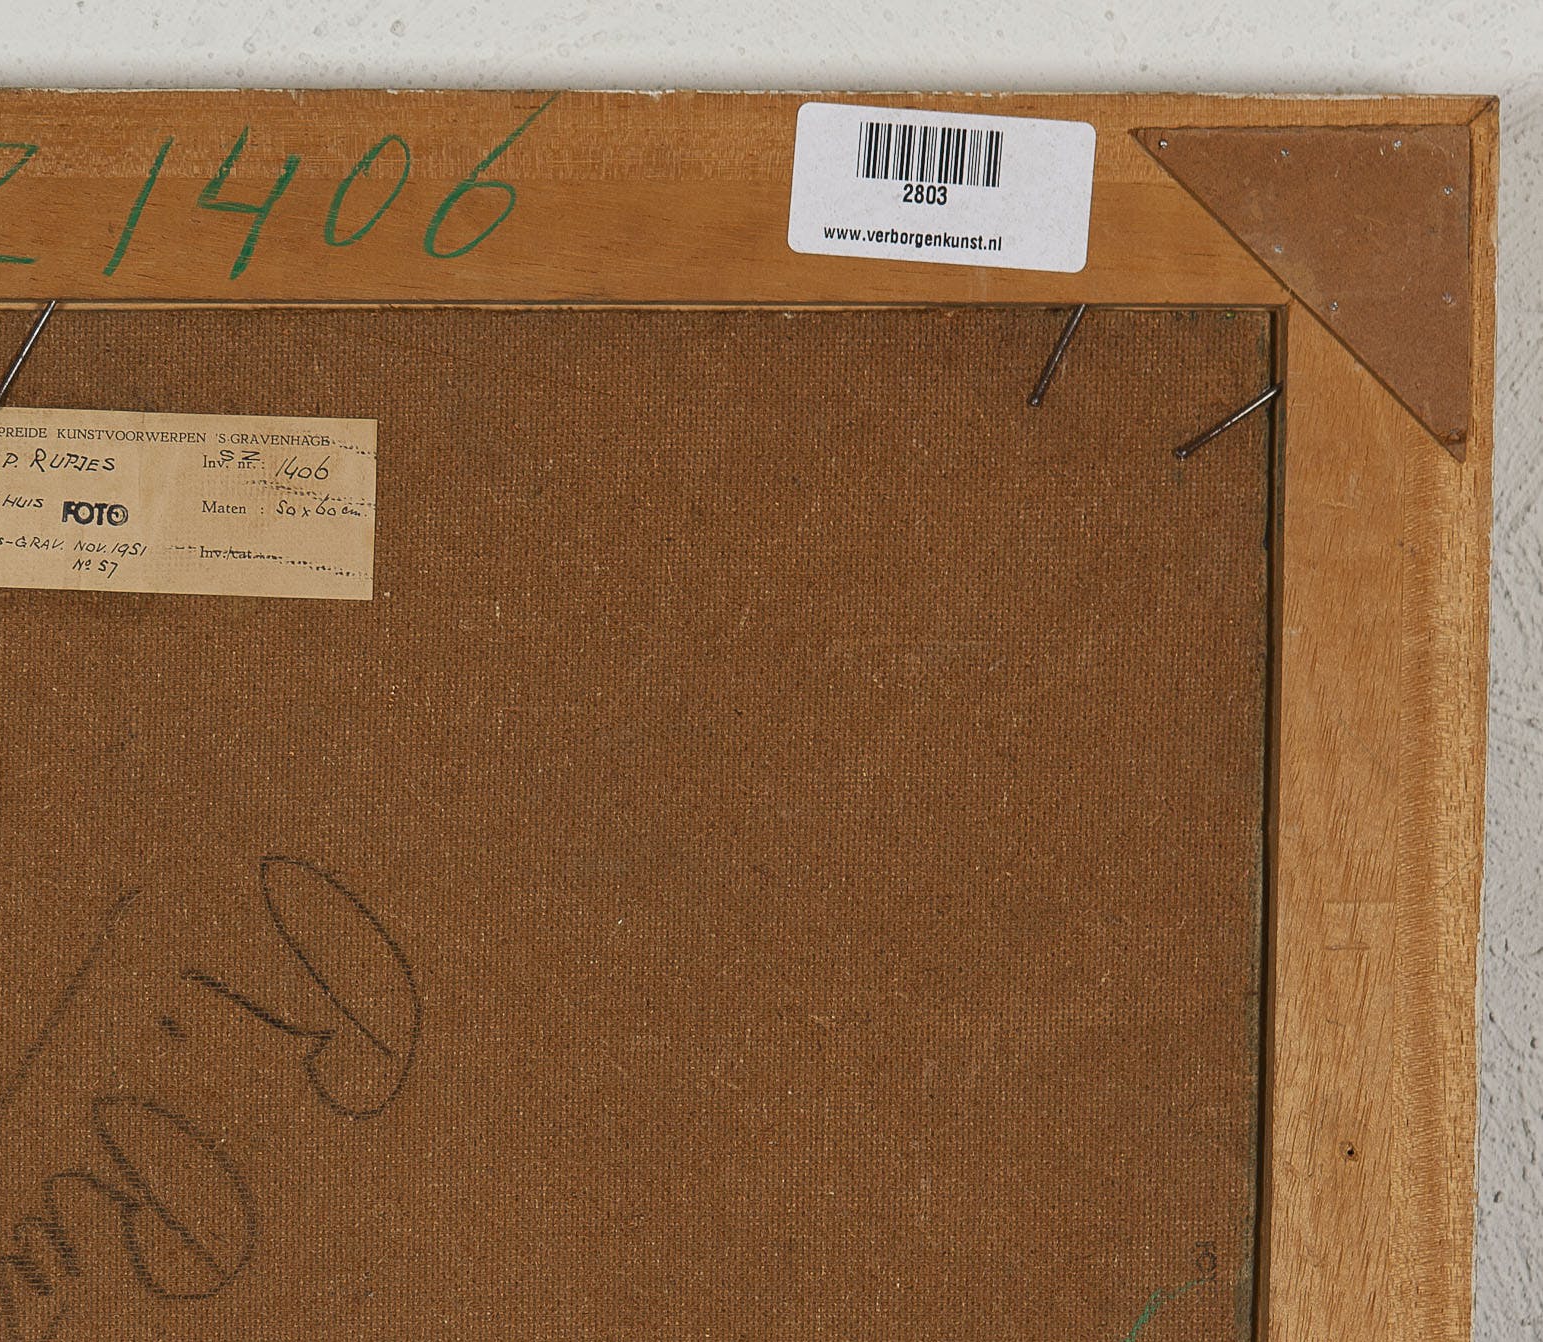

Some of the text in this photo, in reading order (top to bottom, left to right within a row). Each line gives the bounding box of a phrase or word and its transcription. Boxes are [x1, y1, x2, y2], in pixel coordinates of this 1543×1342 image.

[103, 90, 562, 281] 1406
[902, 183, 948, 206] 2803
[824, 226, 1003, 251] www.verborgenkunst.nl
[57, 428, 206, 443] KUNSTVOORWERPEN
[202, 455, 229, 469] Inv.
[275, 455, 330, 480] 1406
[61, 500, 129, 527] FOTO
[202, 500, 247, 514] Maten
